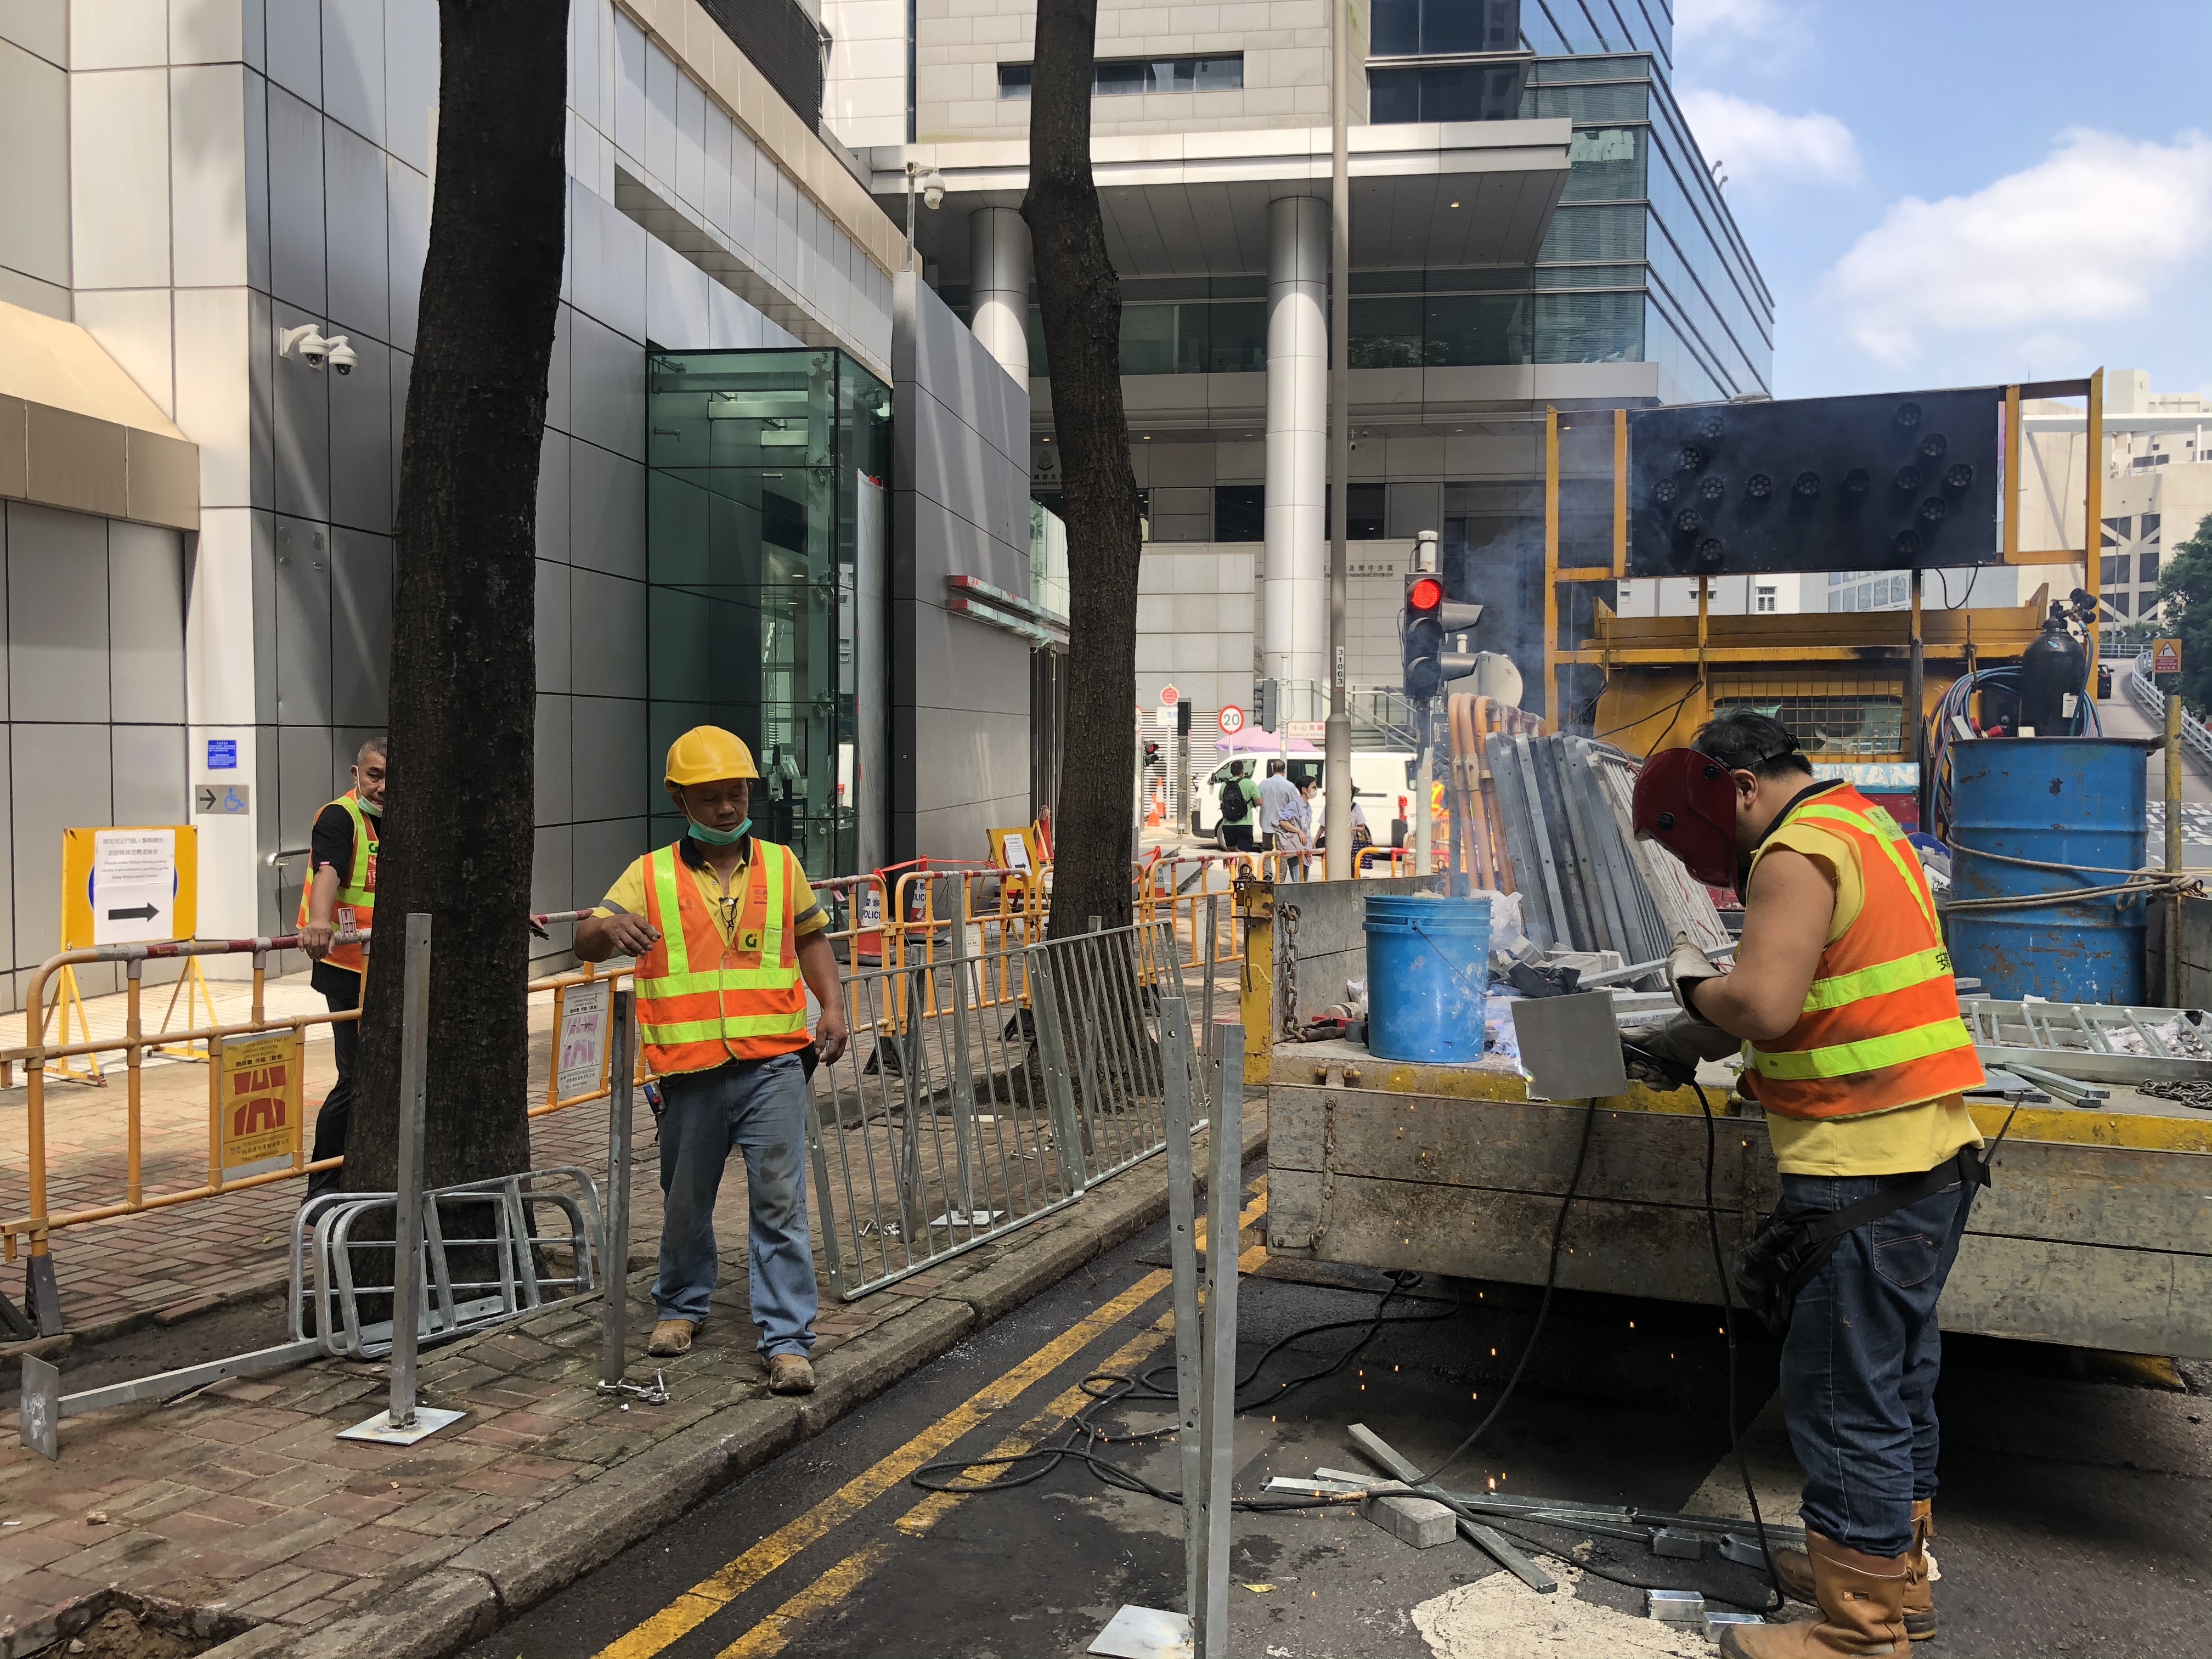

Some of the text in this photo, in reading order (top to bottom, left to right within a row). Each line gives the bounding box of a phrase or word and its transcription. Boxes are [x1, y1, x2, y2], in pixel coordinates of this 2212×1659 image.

[1223, 714, 1239, 725] 20
[228, 1036, 290, 1051] HIGHWAYS DEPARTMENT
